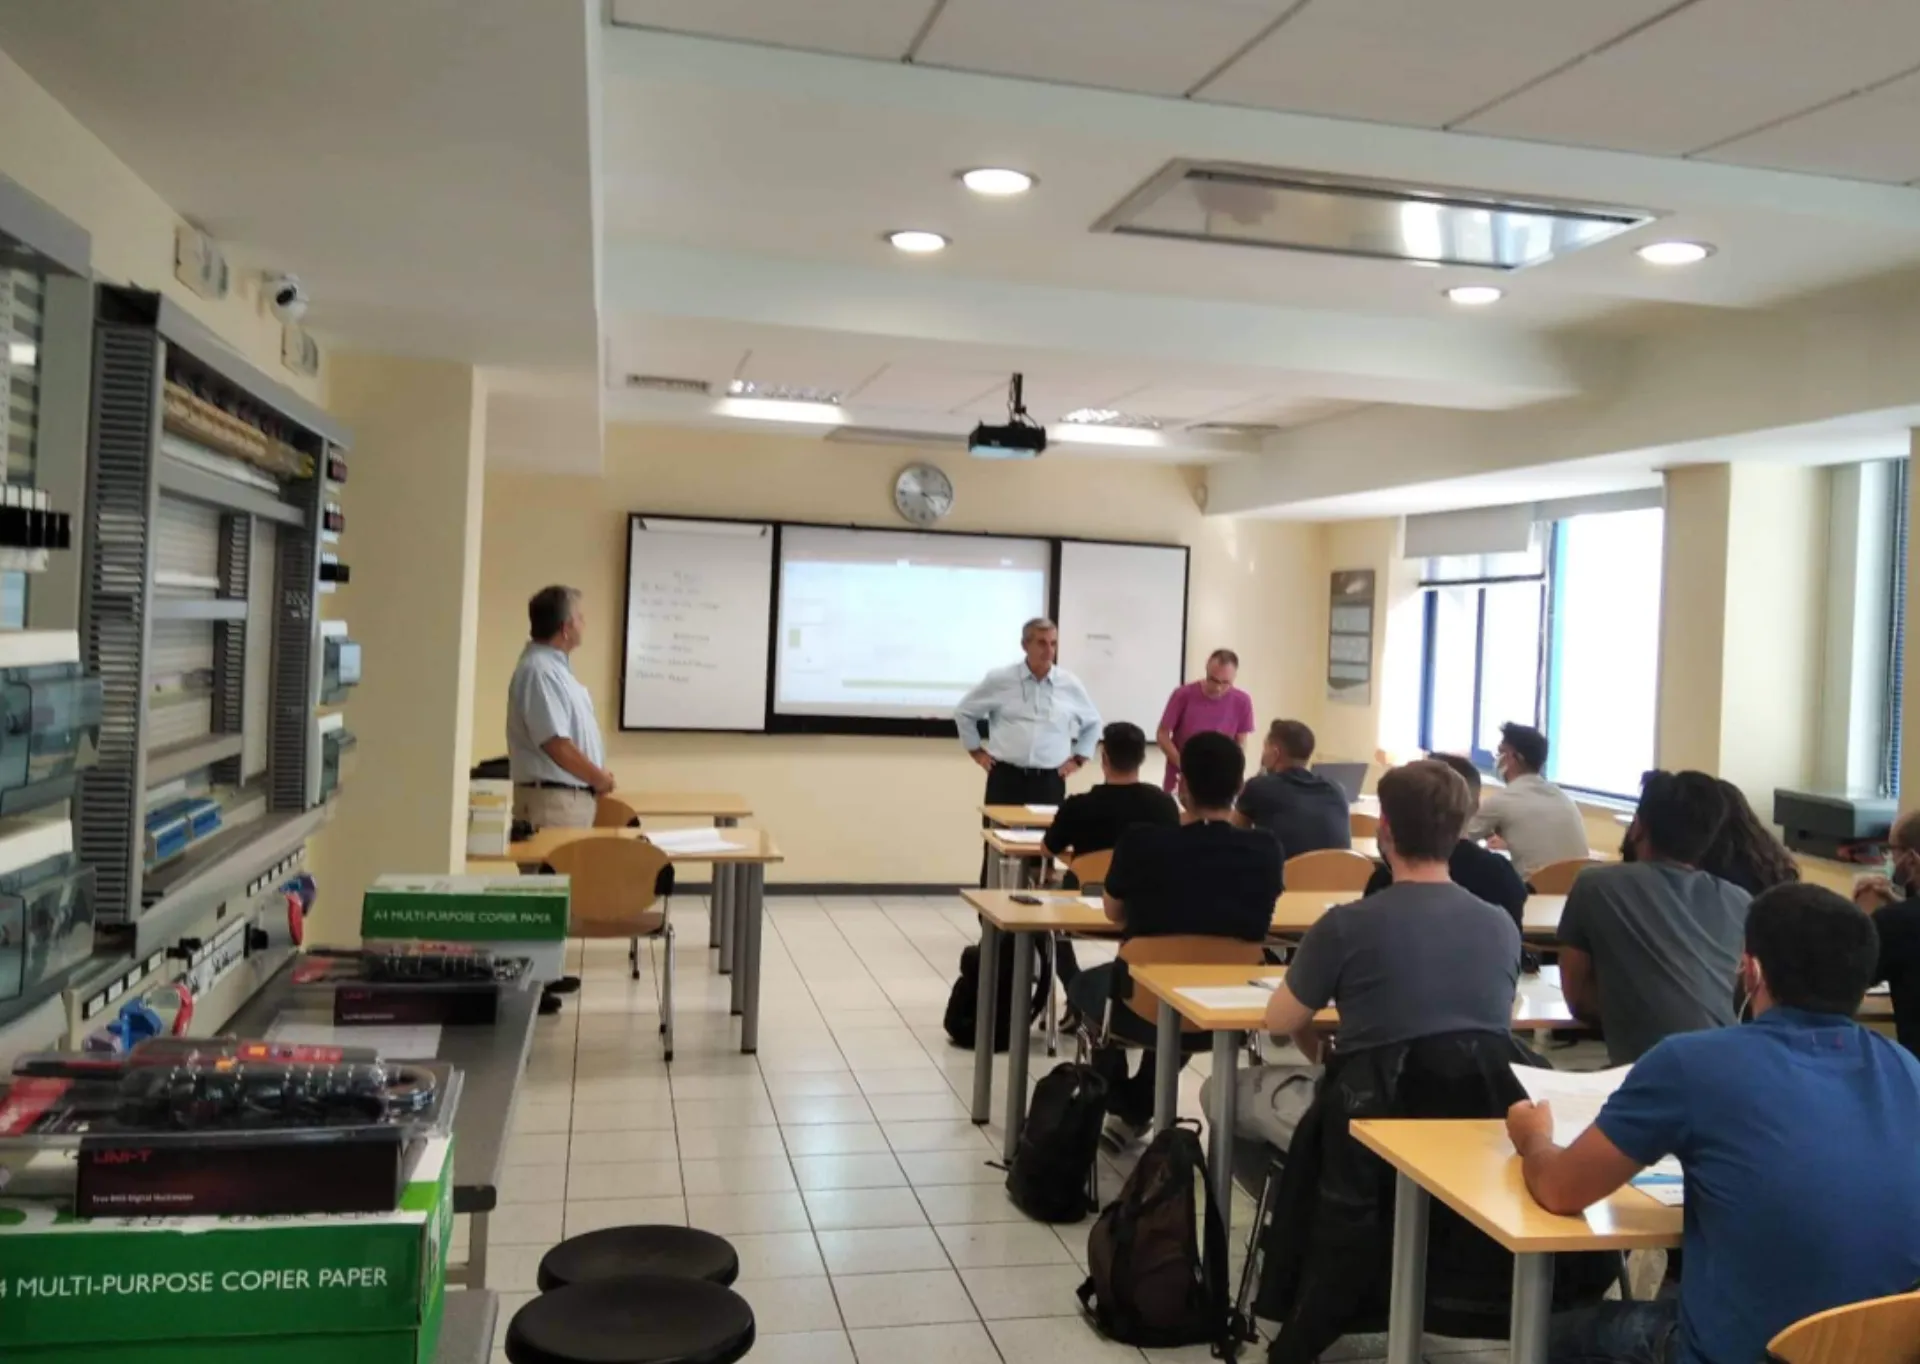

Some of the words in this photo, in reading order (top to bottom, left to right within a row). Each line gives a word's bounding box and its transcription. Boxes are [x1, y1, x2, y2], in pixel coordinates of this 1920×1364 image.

[391, 910, 475, 923] MULTI-PURPOSE
[478, 912, 518, 923] COPIER
[520, 912, 551, 924] PAPER
[16, 1271, 214, 1298] MULTI-PURPOSE
[221, 1269, 310, 1292] COPIER
[318, 1266, 388, 1288] PAPER
